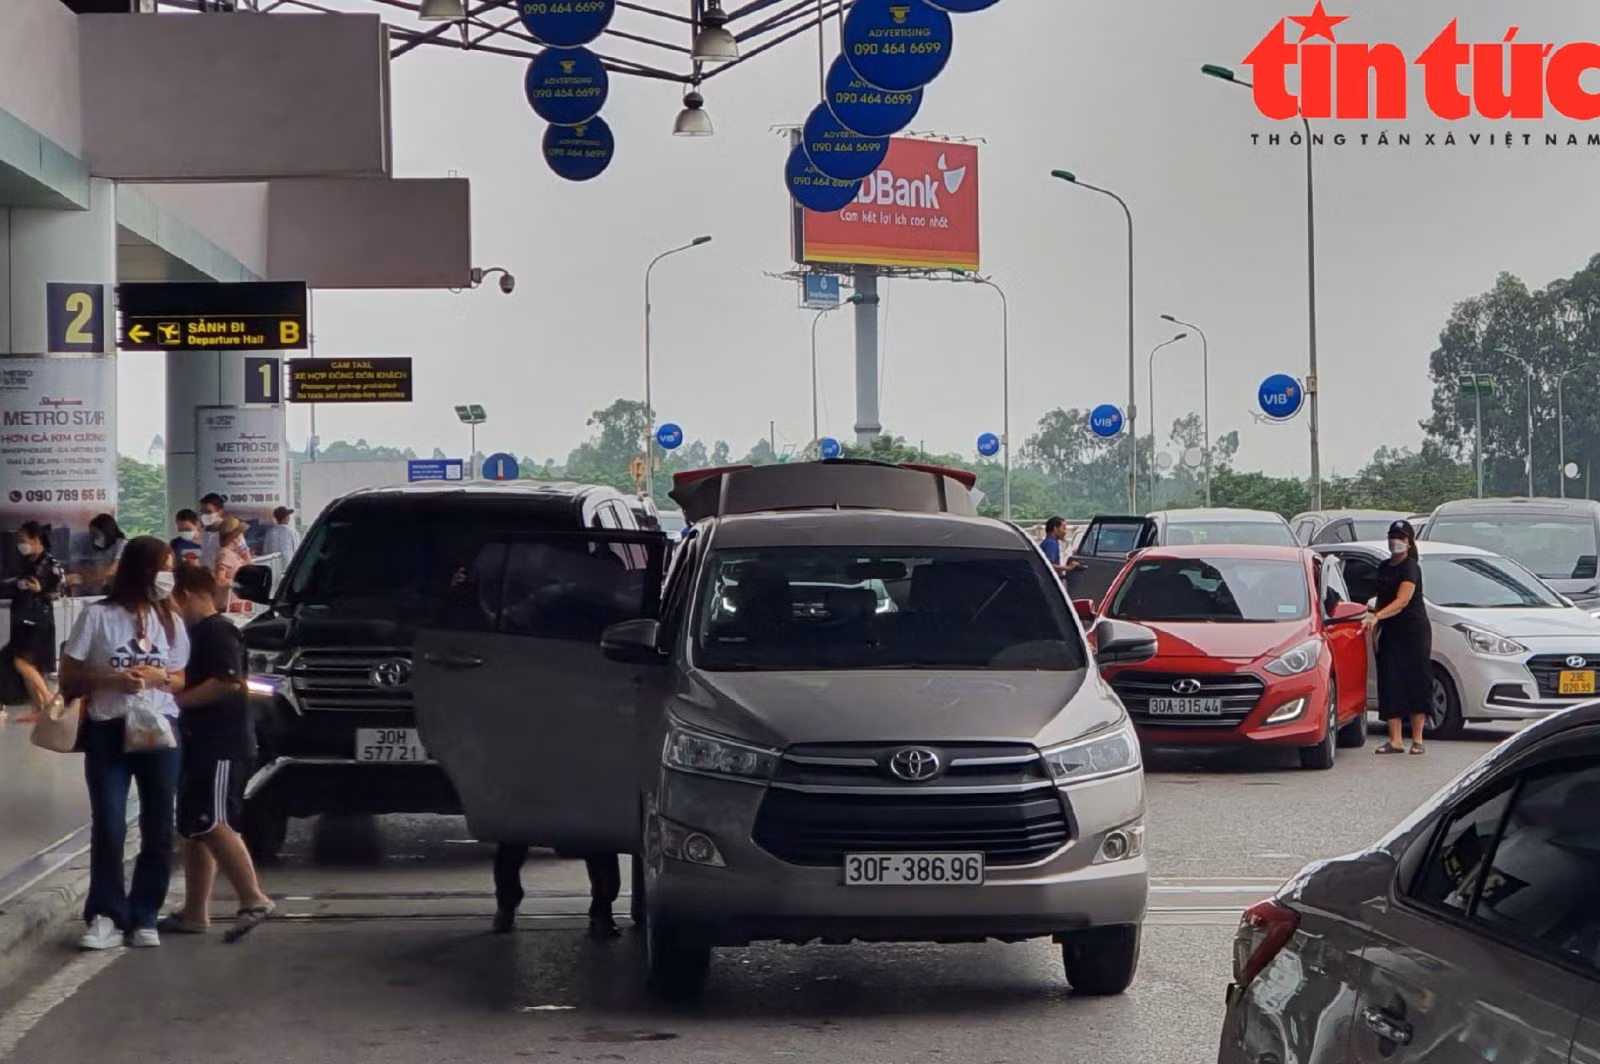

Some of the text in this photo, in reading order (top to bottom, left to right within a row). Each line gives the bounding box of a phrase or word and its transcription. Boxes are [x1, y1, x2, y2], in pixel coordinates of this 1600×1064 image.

[524, 2, 604, 15] 090 464 6699
[868, 28, 931, 37] ADVERTISING
[854, 42, 941, 55] 090 464 6699
[532, 89, 552, 98] 090
[575, 87, 601, 97] 6699
[835, 93, 913, 104] 090 464 6699
[812, 142, 832, 152] 090
[834, 143, 853, 152] 464
[793, 177, 811, 186] 090
[852, 169, 940, 209] DBank
[64, 293, 94, 344] 2
[188, 318, 245, 333] SẢNH ĐI
[279, 321, 300, 344] B
[187, 335, 264, 346] Departure Hall
[257, 363, 272, 398] 1
[1263, 393, 1288, 405] VIB
[3, 411, 69, 426] METRO
[1094, 417, 1113, 427] VIB
[51, 433, 71, 442] KIM
[216, 442, 258, 452] METRO
[26, 489, 53, 502] 090
[55, 489, 79, 501] 789
[110, 653, 166, 669] adidas
[376, 730, 407, 745] 30H
[849, 856, 979, 882] 30F-386.96
